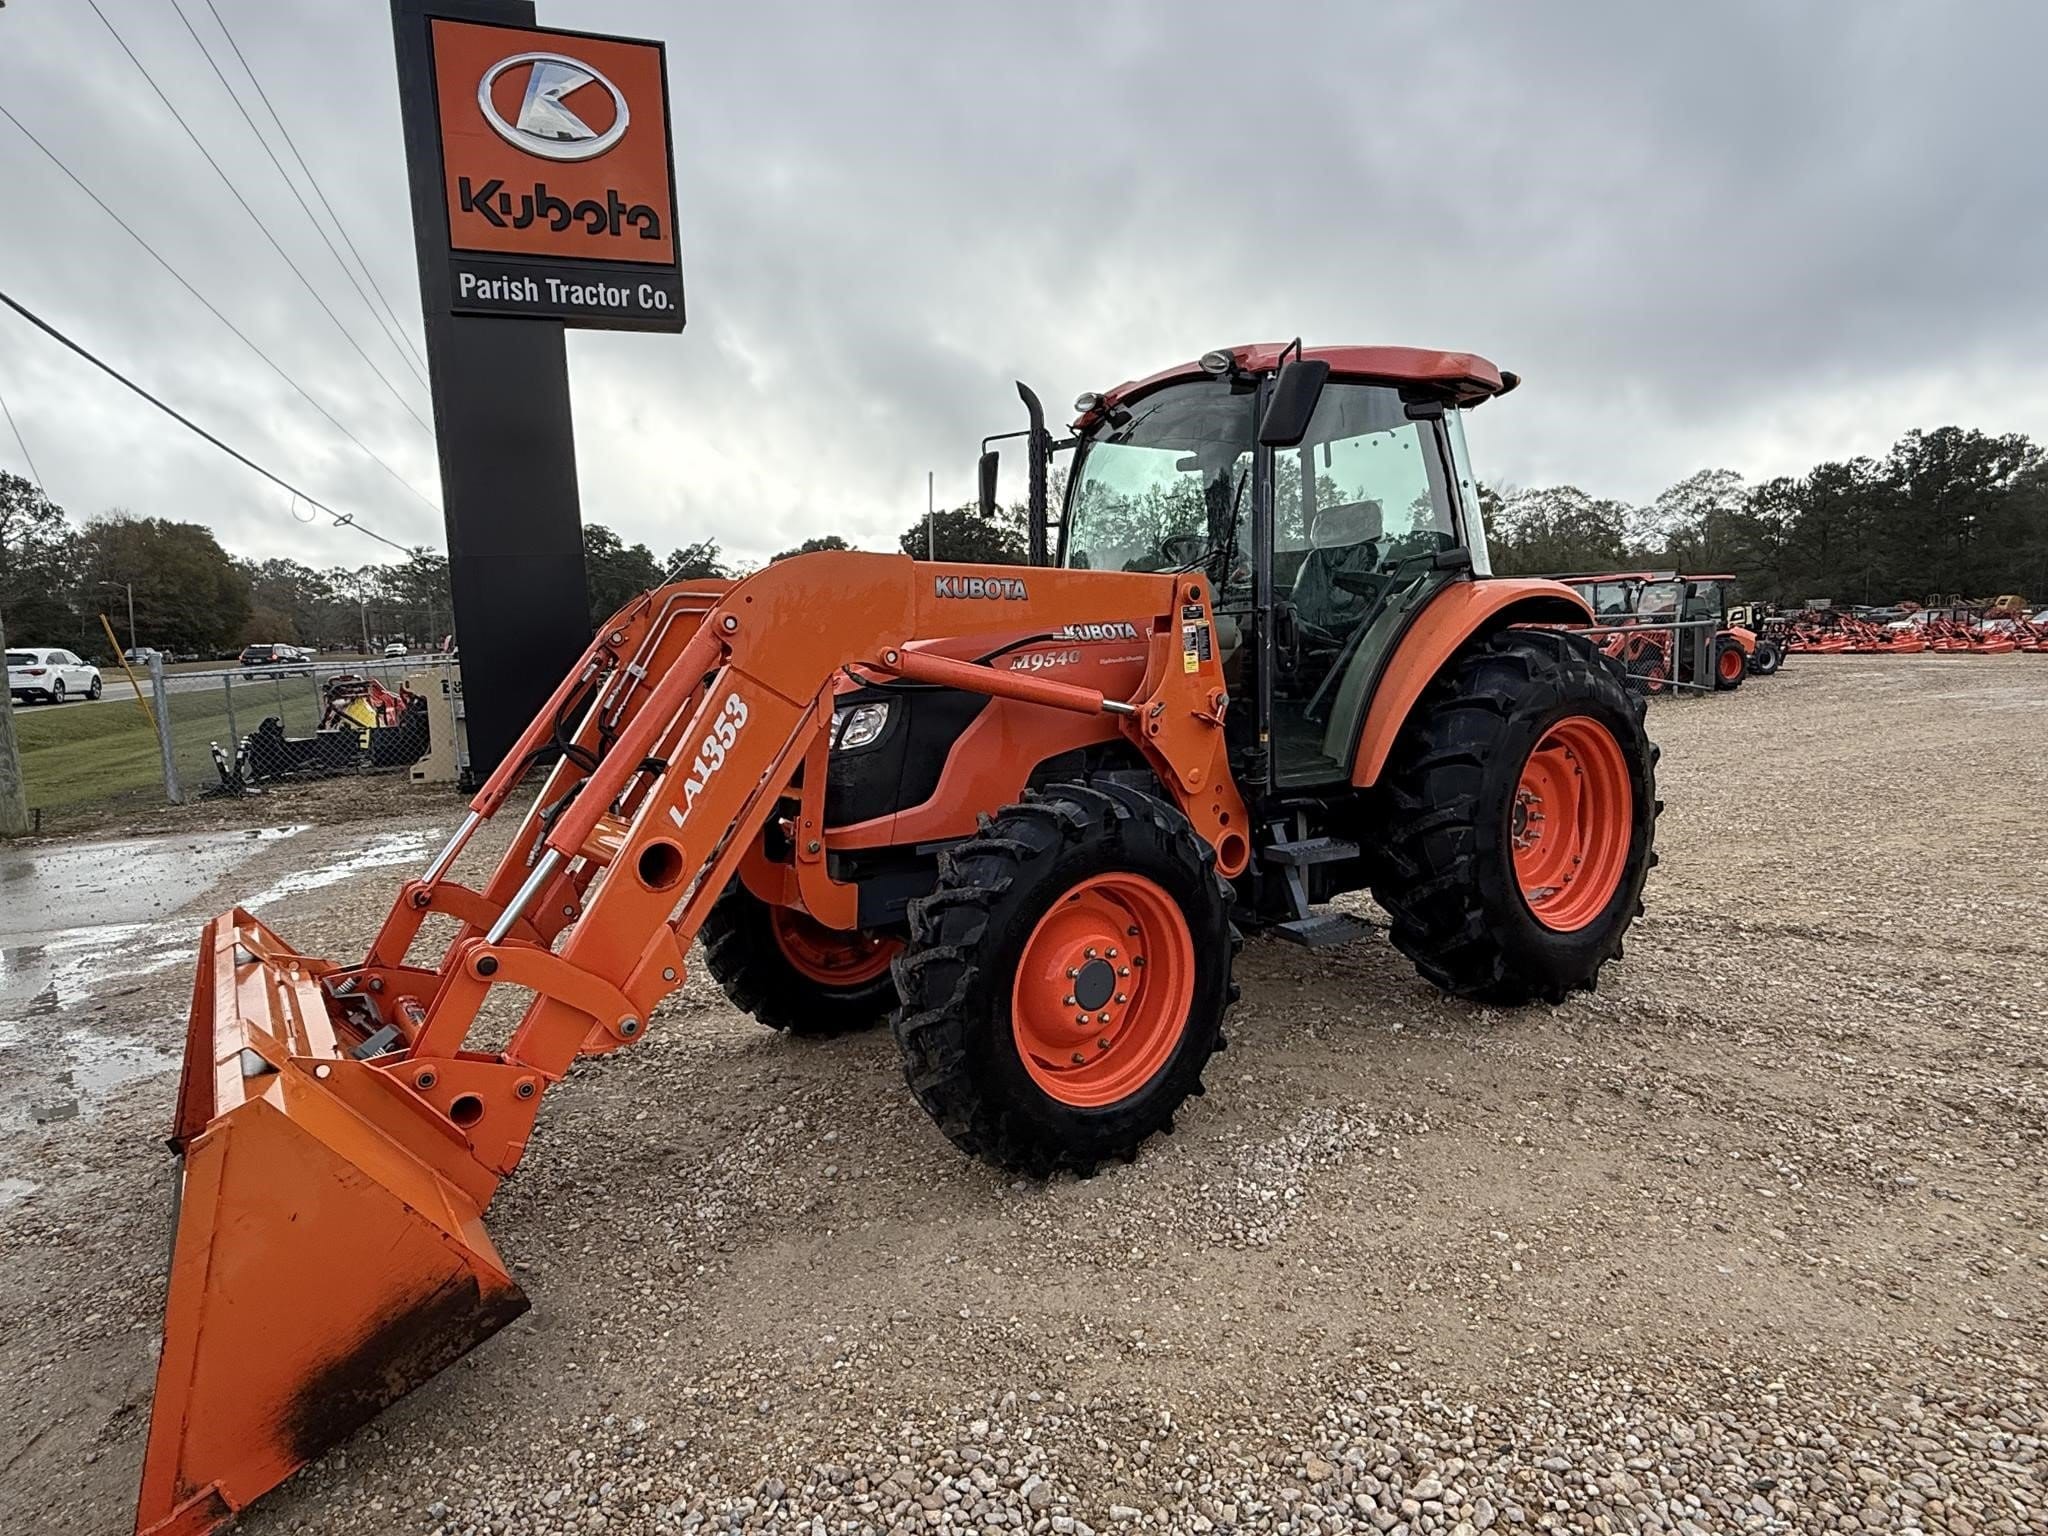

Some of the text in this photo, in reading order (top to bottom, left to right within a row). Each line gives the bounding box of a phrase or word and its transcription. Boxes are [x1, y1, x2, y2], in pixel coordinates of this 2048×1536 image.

[459, 176, 661, 240] Kubota
[459, 272, 675, 310] Parish Tractor Co.
[935, 575, 1028, 601] KUBOTA
[1063, 623, 1138, 641] KUBOTA
[669, 693, 748, 828] LA1353
